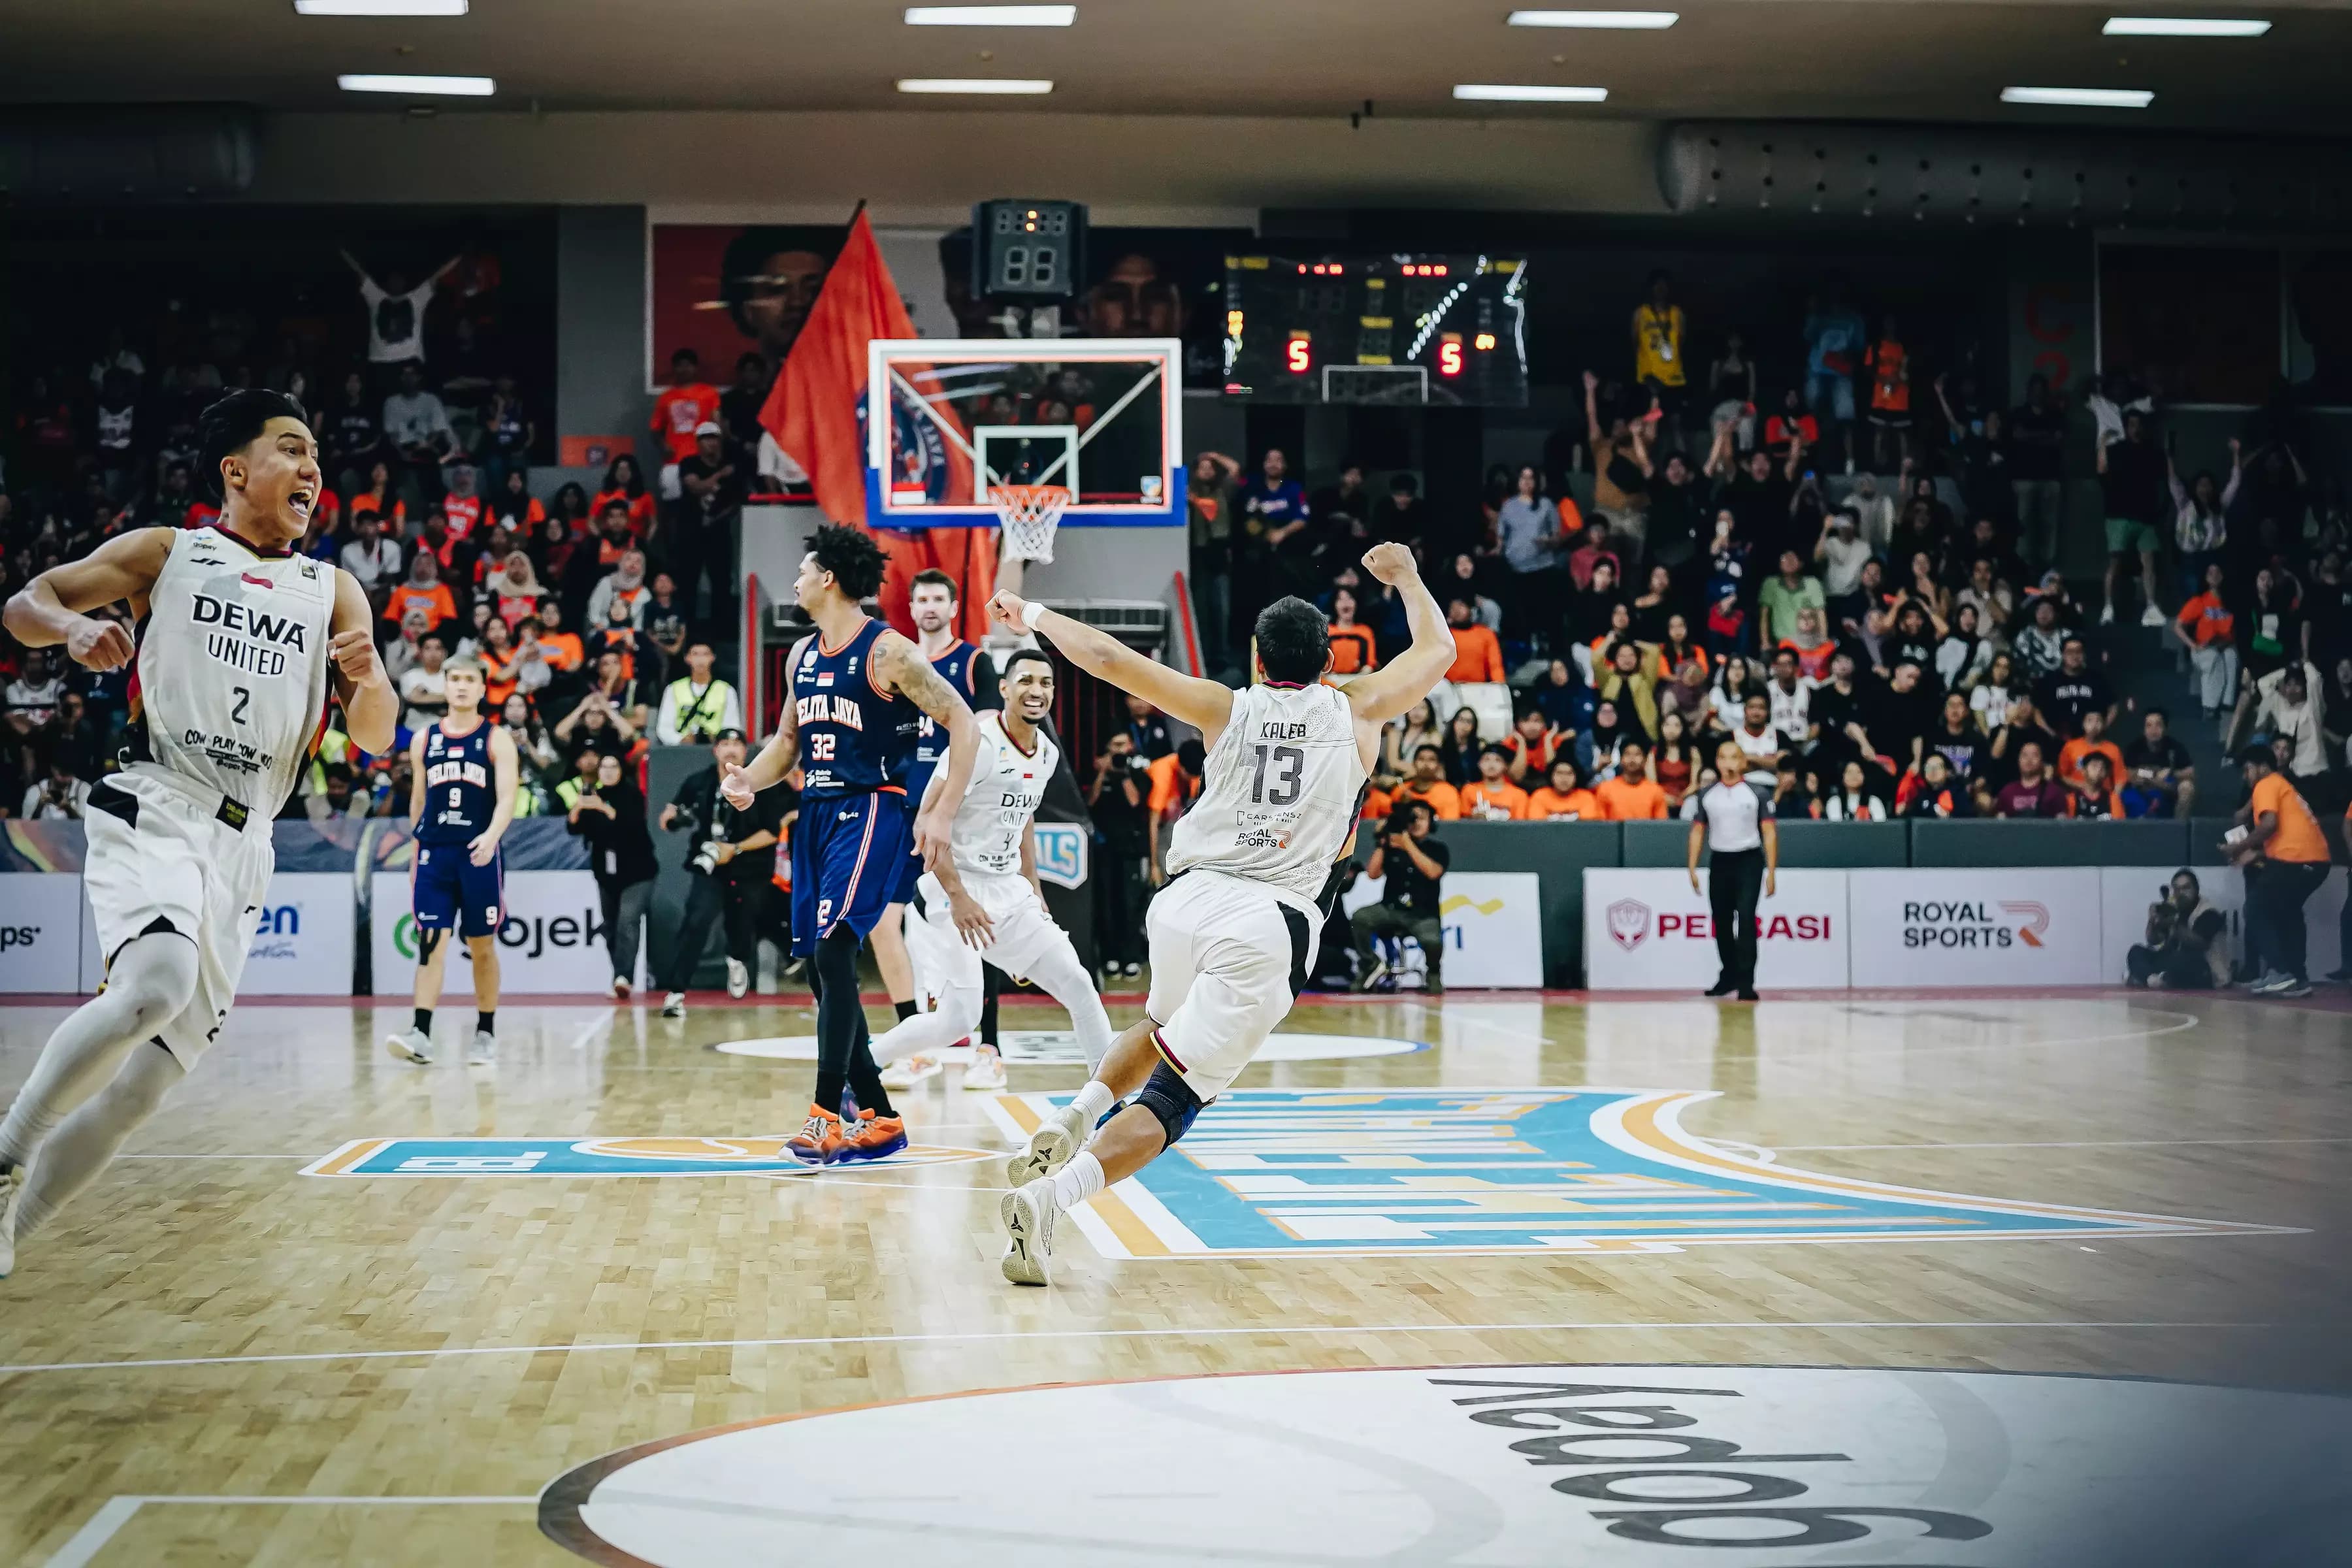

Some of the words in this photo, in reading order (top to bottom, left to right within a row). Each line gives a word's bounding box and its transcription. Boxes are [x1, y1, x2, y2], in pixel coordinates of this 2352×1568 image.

[1288, 339, 1309, 372] 5
[1441, 342, 1462, 374] 5
[192, 594, 306, 654] DEWA
[208, 634, 285, 675] UNITED
[232, 686, 250, 725] 2
[831, 696, 862, 731] JAYA
[185, 729, 206, 744] COW
[213, 736, 236, 751] PLAY
[1260, 722, 1306, 739] KALEB
[811, 734, 836, 760] 32
[1252, 745, 1304, 805] 13
[449, 787, 461, 808] 9
[1235, 838, 1277, 847] SPORTS
[1238, 828, 1271, 840] ROYAL
[1904, 902, 1993, 922] ROYAL
[1658, 914, 1831, 939] PEASI
[1904, 927, 2012, 947] SPORTS
[1426, 1379, 1994, 1548] gopay
